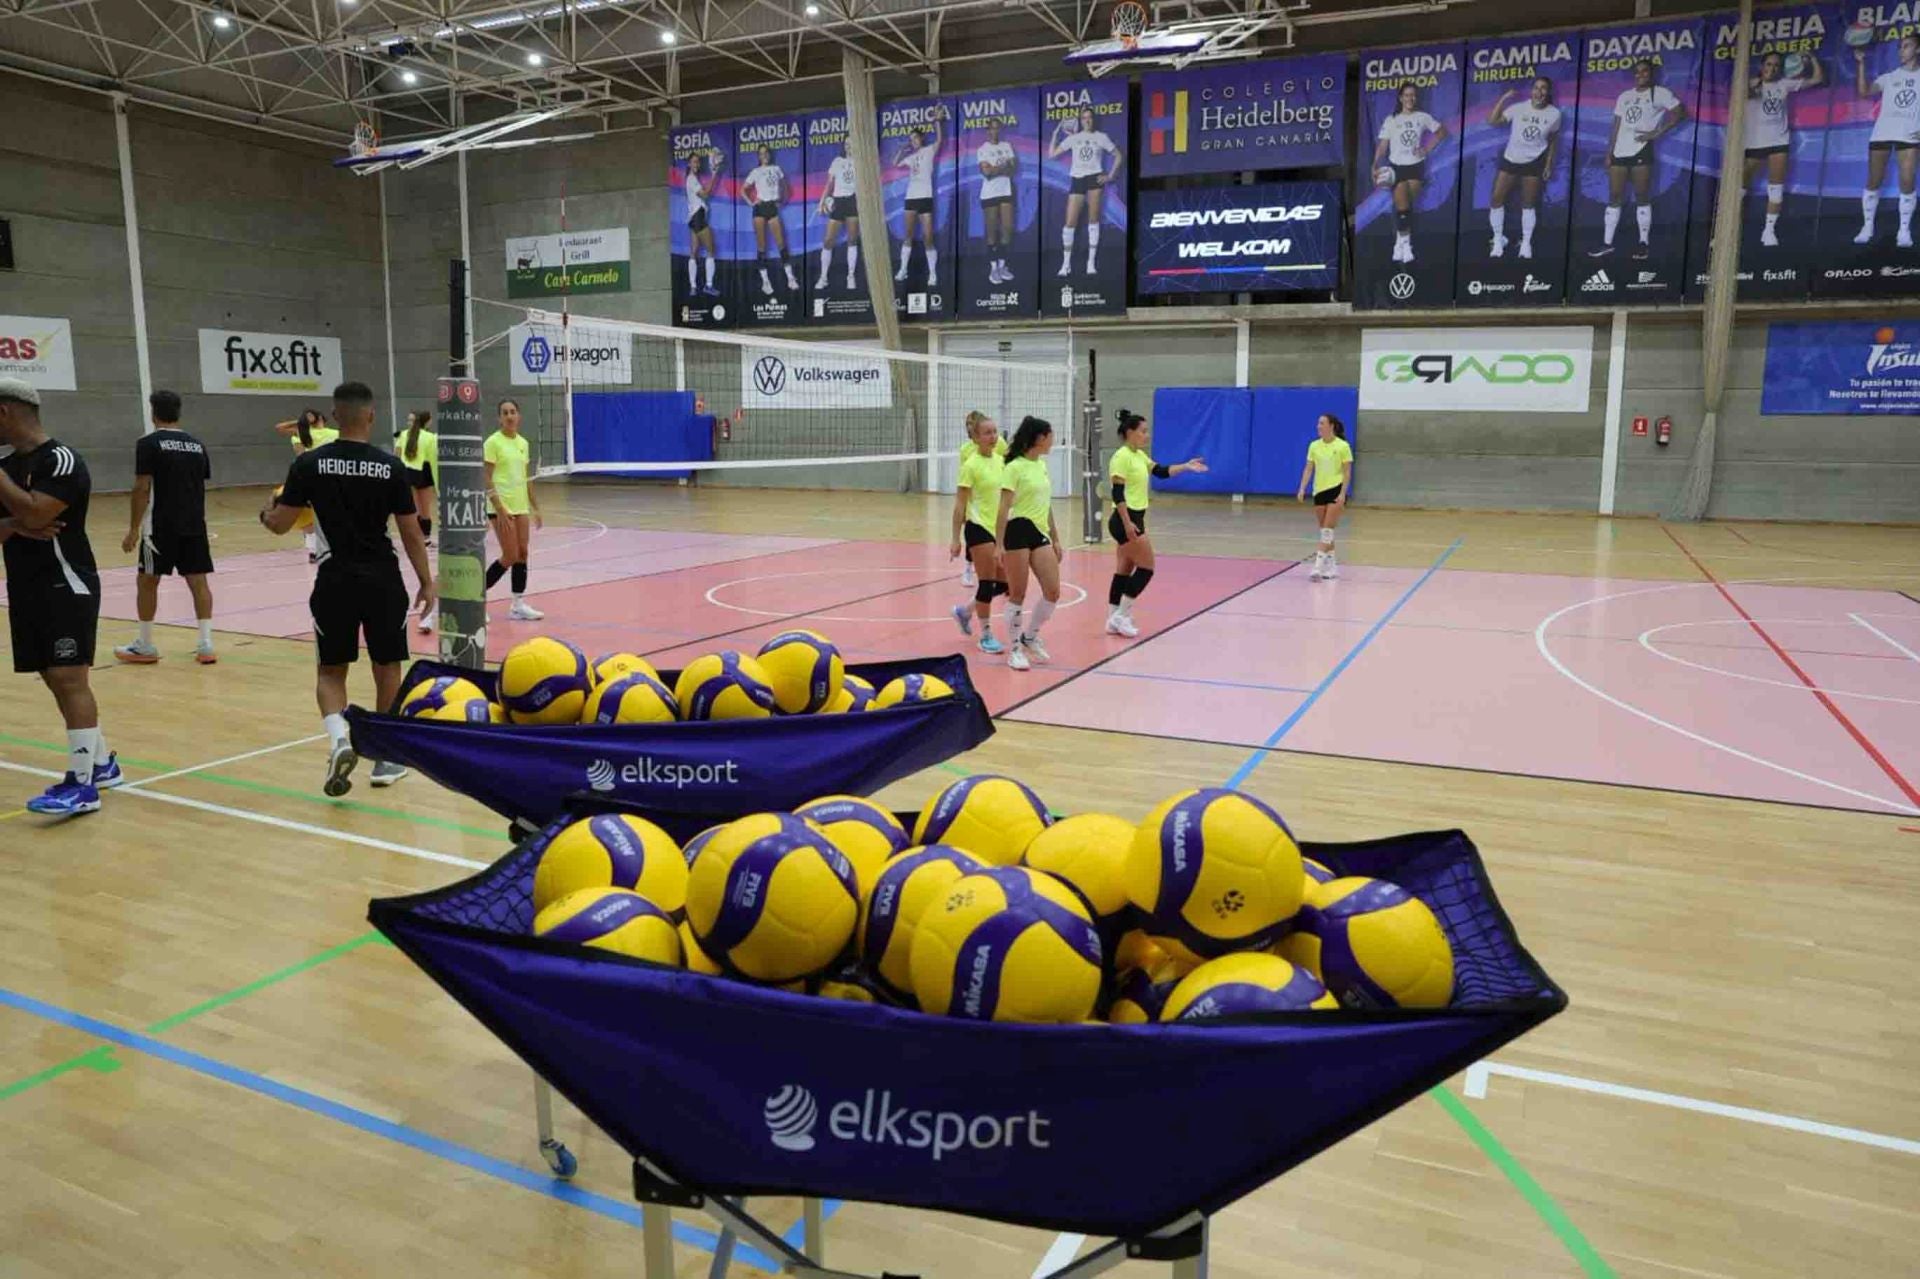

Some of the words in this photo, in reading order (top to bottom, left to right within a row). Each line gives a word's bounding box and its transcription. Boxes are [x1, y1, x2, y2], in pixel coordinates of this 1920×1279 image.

[1588, 29, 1695, 58] DAYANA
[1473, 42, 1571, 68] CAMILA
[1366, 54, 1457, 78] CLAUDIA
[1473, 68, 1536, 82] HIRUELA
[1201, 77, 1334, 100] COLEGIO
[963, 99, 1005, 117] WIN
[1046, 89, 1091, 109] LOLA
[1201, 99, 1334, 130] Heidelberg
[674, 130, 711, 149] SOFÍA
[739, 123, 801, 142] CANDELA
[1201, 138, 1245, 150] GRAN
[1255, 132, 1332, 146] CANARIA
[1150, 205, 1323, 228] BIENVENIDAS
[1178, 239, 1291, 258] WELKOM
[574, 268, 619, 286] Carmelo
[224, 335, 323, 379] fix&fit
[553, 346, 620, 365] Hexagon
[794, 367, 880, 384] Volkswagen
[318, 458, 391, 479] HEIDELBERG
[621, 757, 738, 789] elksport
[829, 1088, 1050, 1161] elksport
